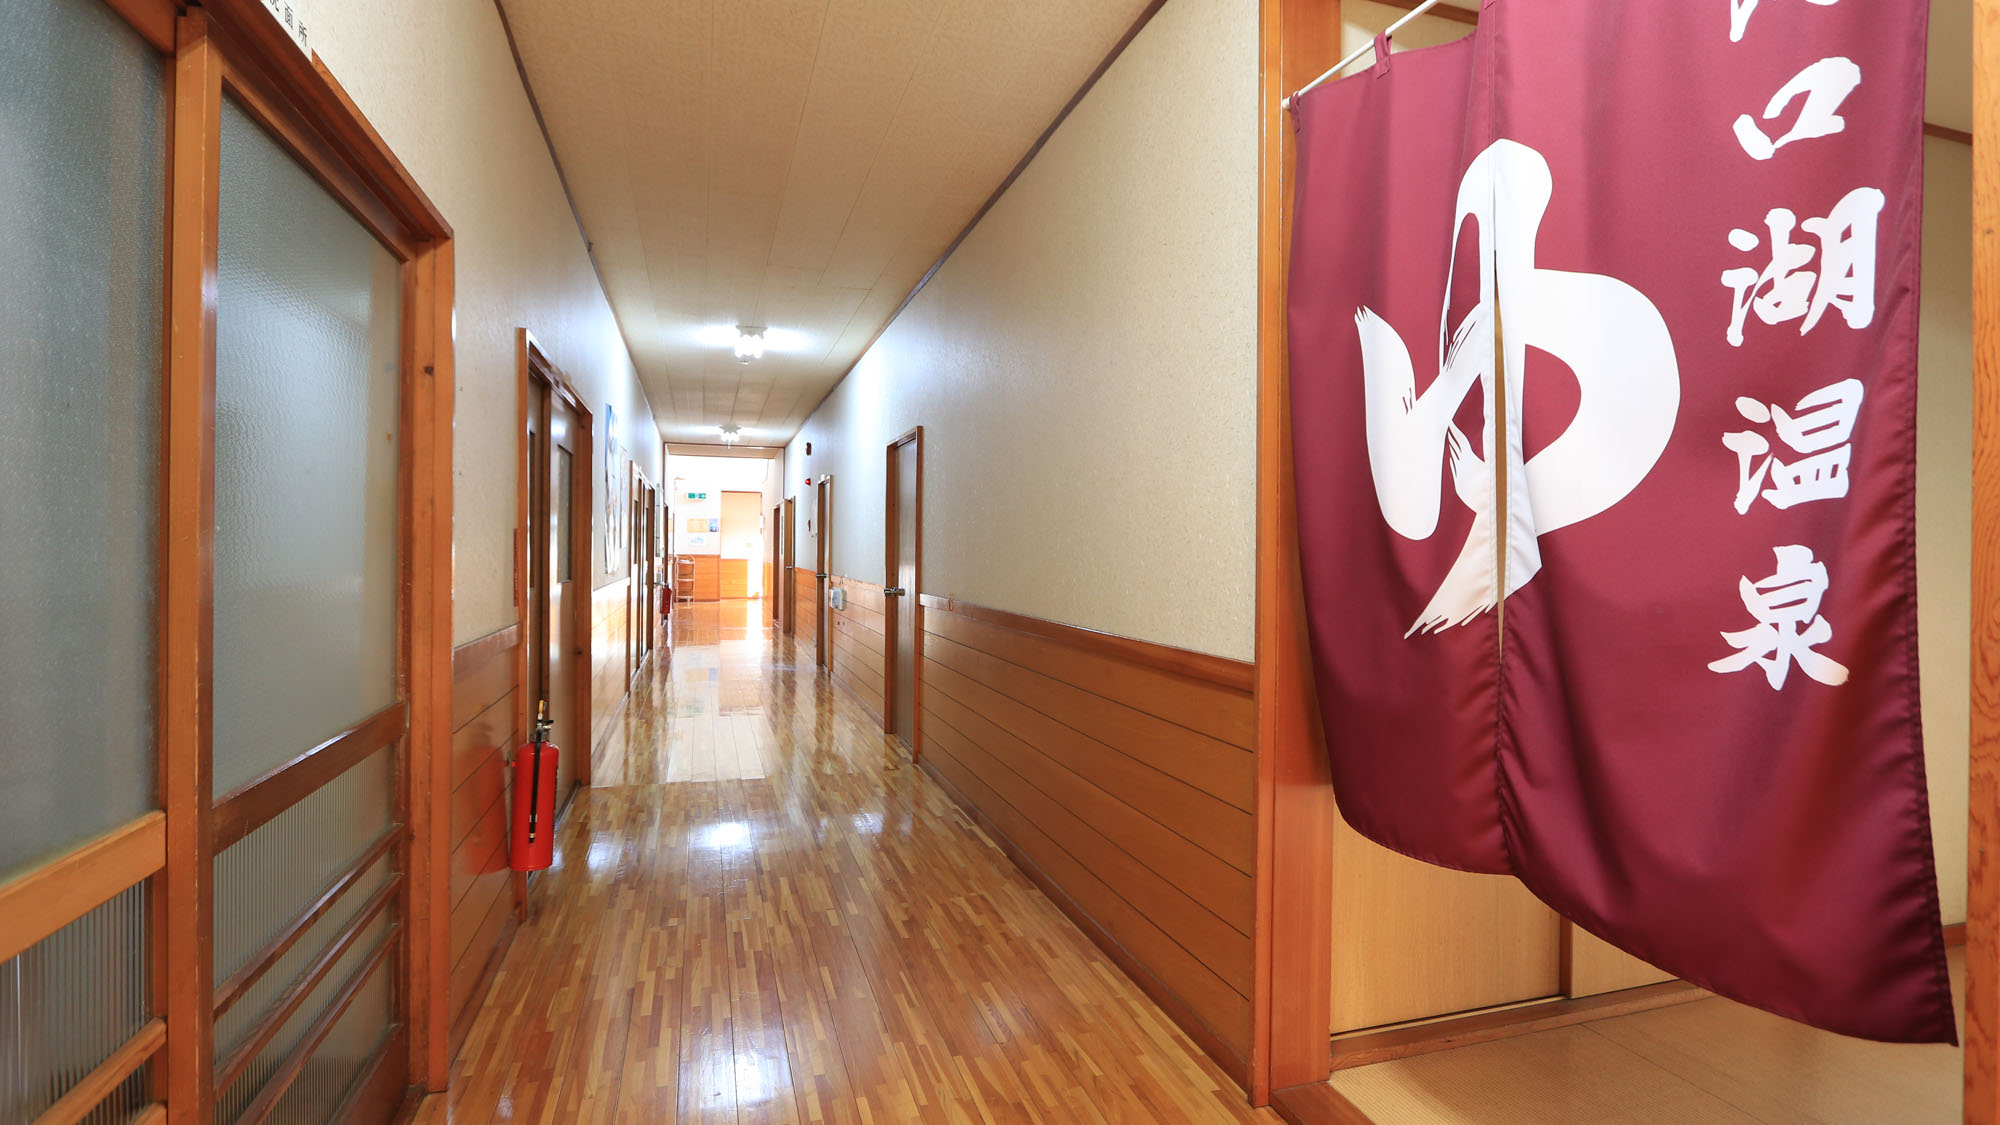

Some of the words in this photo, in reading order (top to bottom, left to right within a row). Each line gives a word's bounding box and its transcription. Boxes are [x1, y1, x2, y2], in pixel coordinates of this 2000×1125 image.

[1354, 138, 1681, 639] ゆ
[1708, 0, 1885, 691] 口湖温泉
